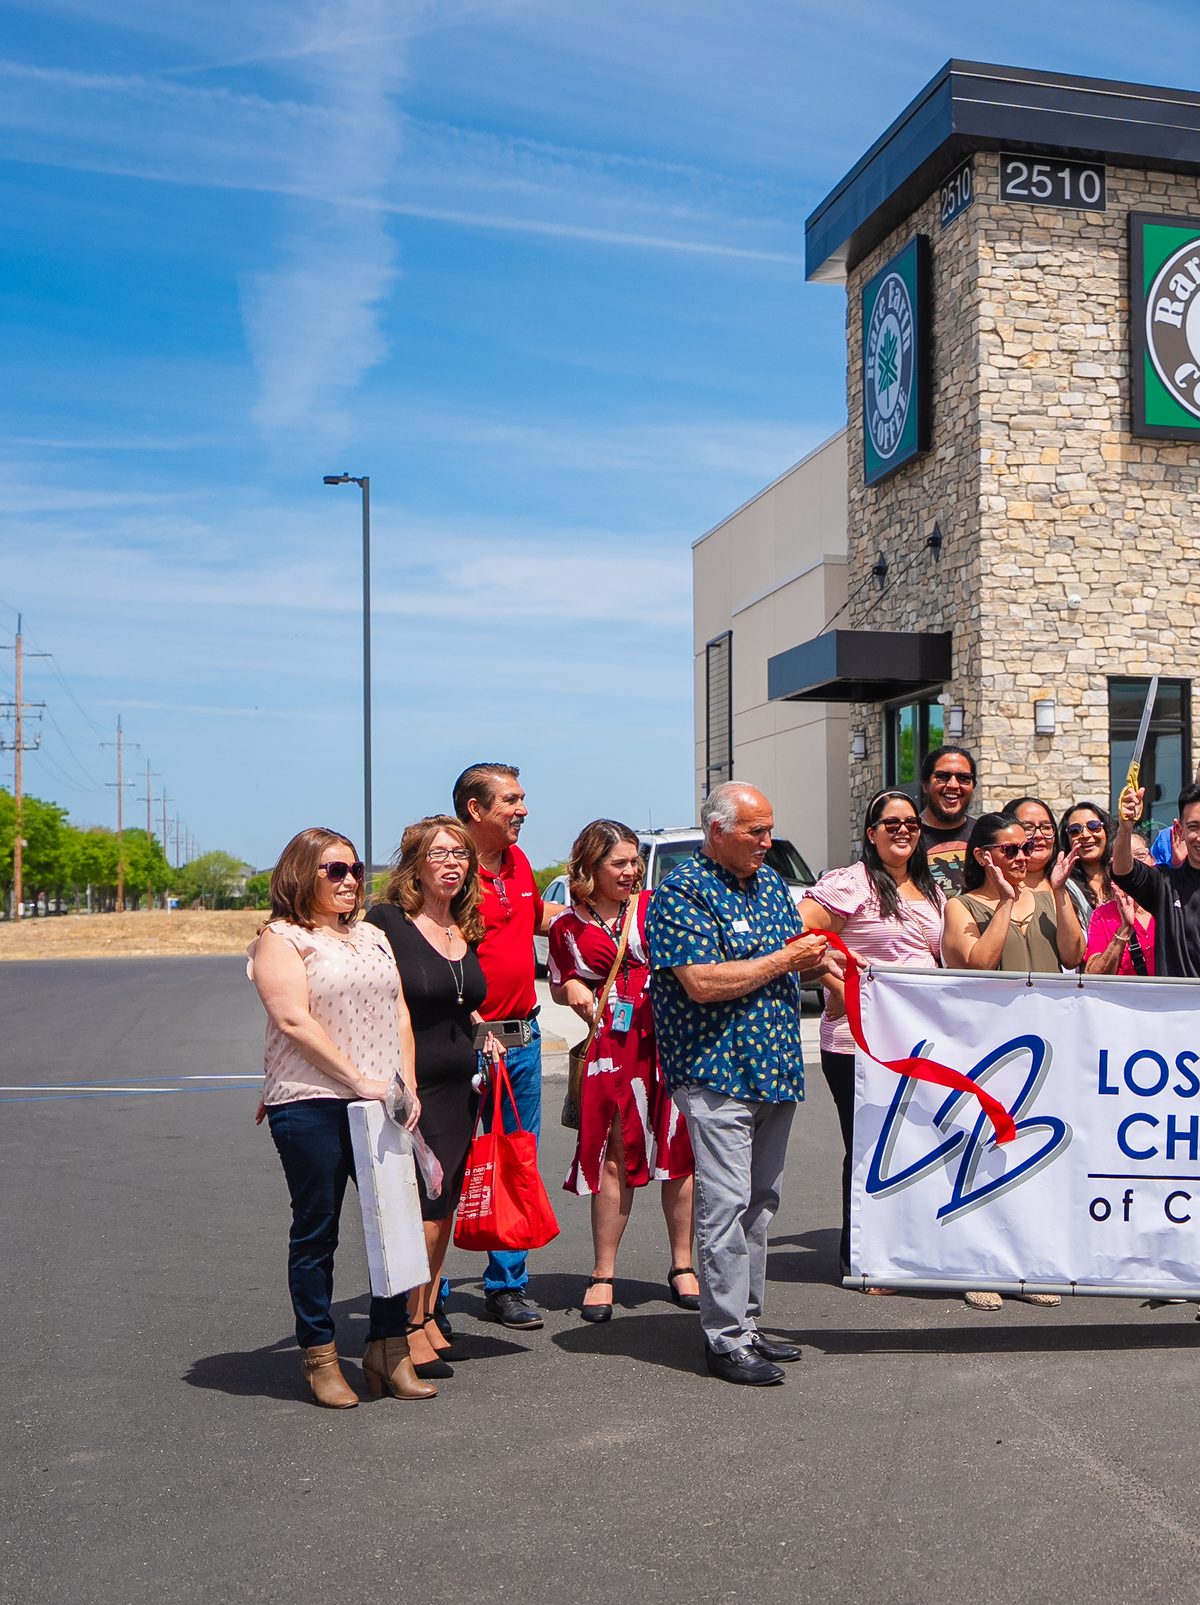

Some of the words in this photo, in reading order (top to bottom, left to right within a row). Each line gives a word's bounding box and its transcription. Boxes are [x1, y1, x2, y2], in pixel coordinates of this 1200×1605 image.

[941, 167, 971, 221] 2510
[1005, 161, 1100, 204] 2510
[1097, 1048, 1200, 1099] LOS
[1088, 1188, 1134, 1223] of
